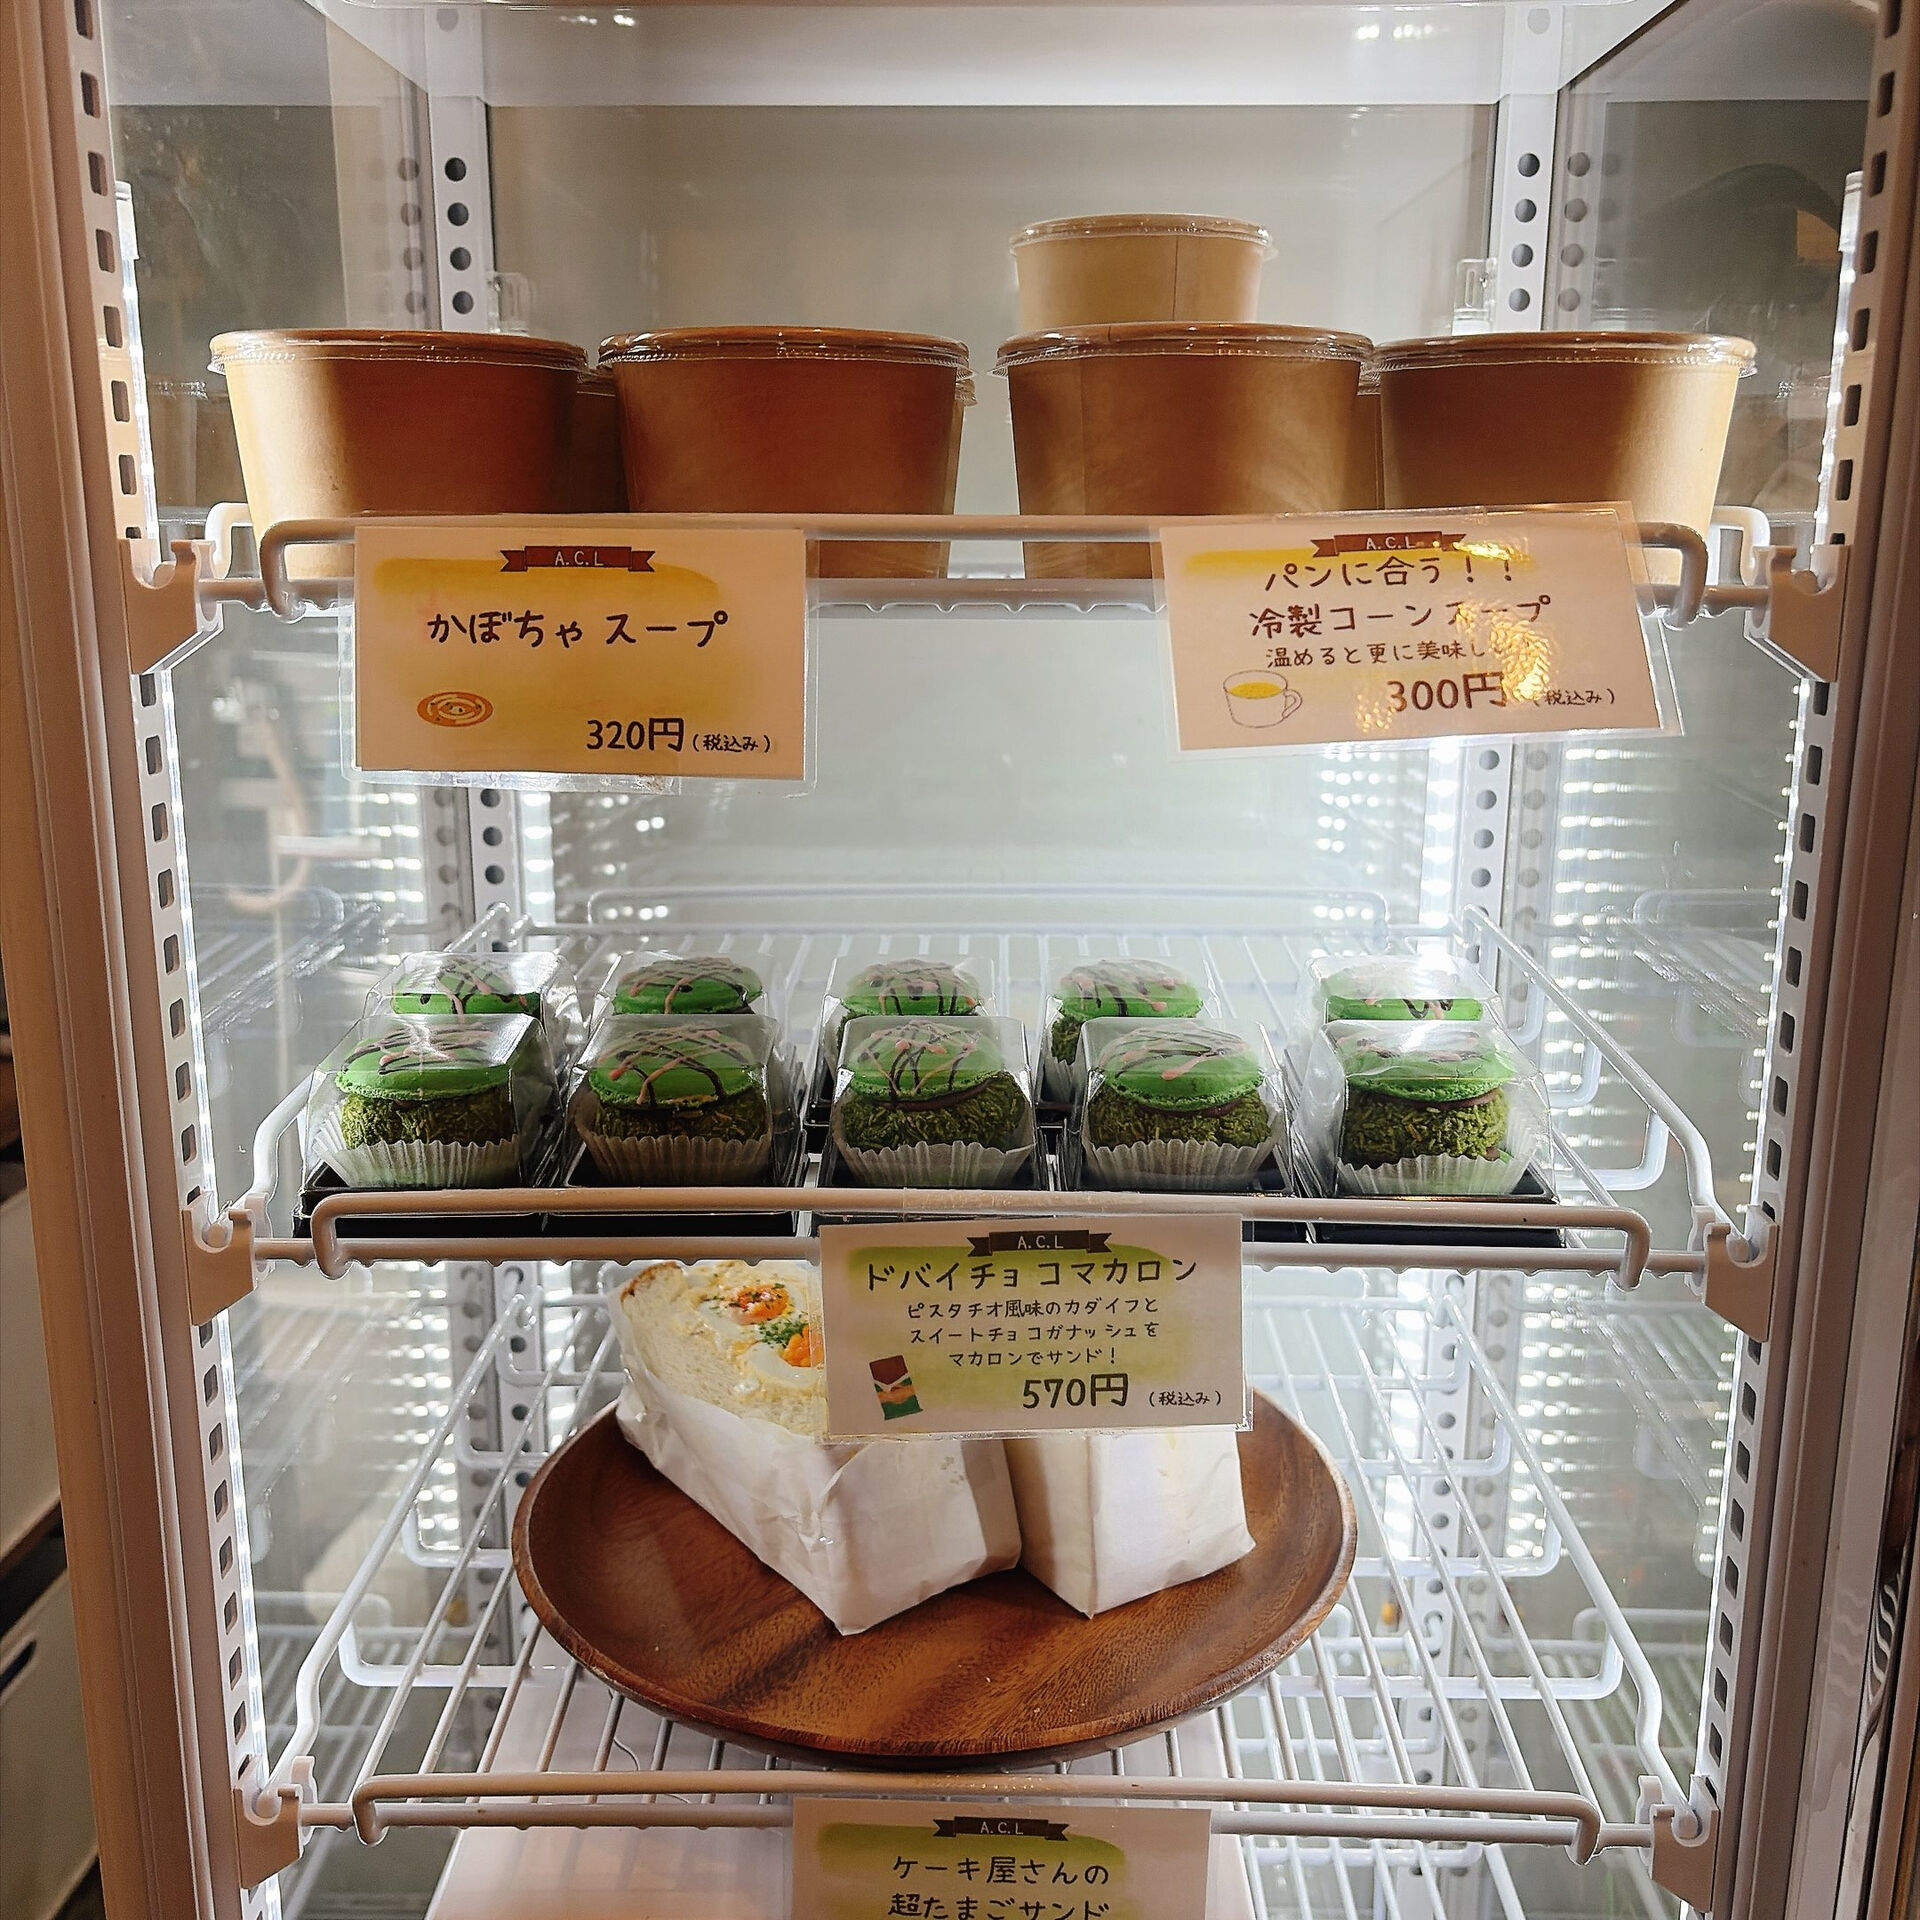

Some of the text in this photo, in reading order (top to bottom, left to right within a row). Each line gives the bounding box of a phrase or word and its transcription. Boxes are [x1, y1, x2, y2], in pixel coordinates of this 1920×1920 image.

[1366, 535, 1416, 550] A.C.L
[555, 551, 605, 567] A.C.L
[586, 717, 684, 752] 320円
[1017, 1234, 1065, 1250] A.C.L
[908, 1297, 1159, 1319] ピスタチオ風味のカダイフと
[1022, 1373, 1129, 1410] 570円
[980, 1820, 1024, 1836] A.C.L
[892, 1855, 1110, 1886] ケーキ屋さんの
[888, 1893, 1110, 1920] 超たまごサンド
